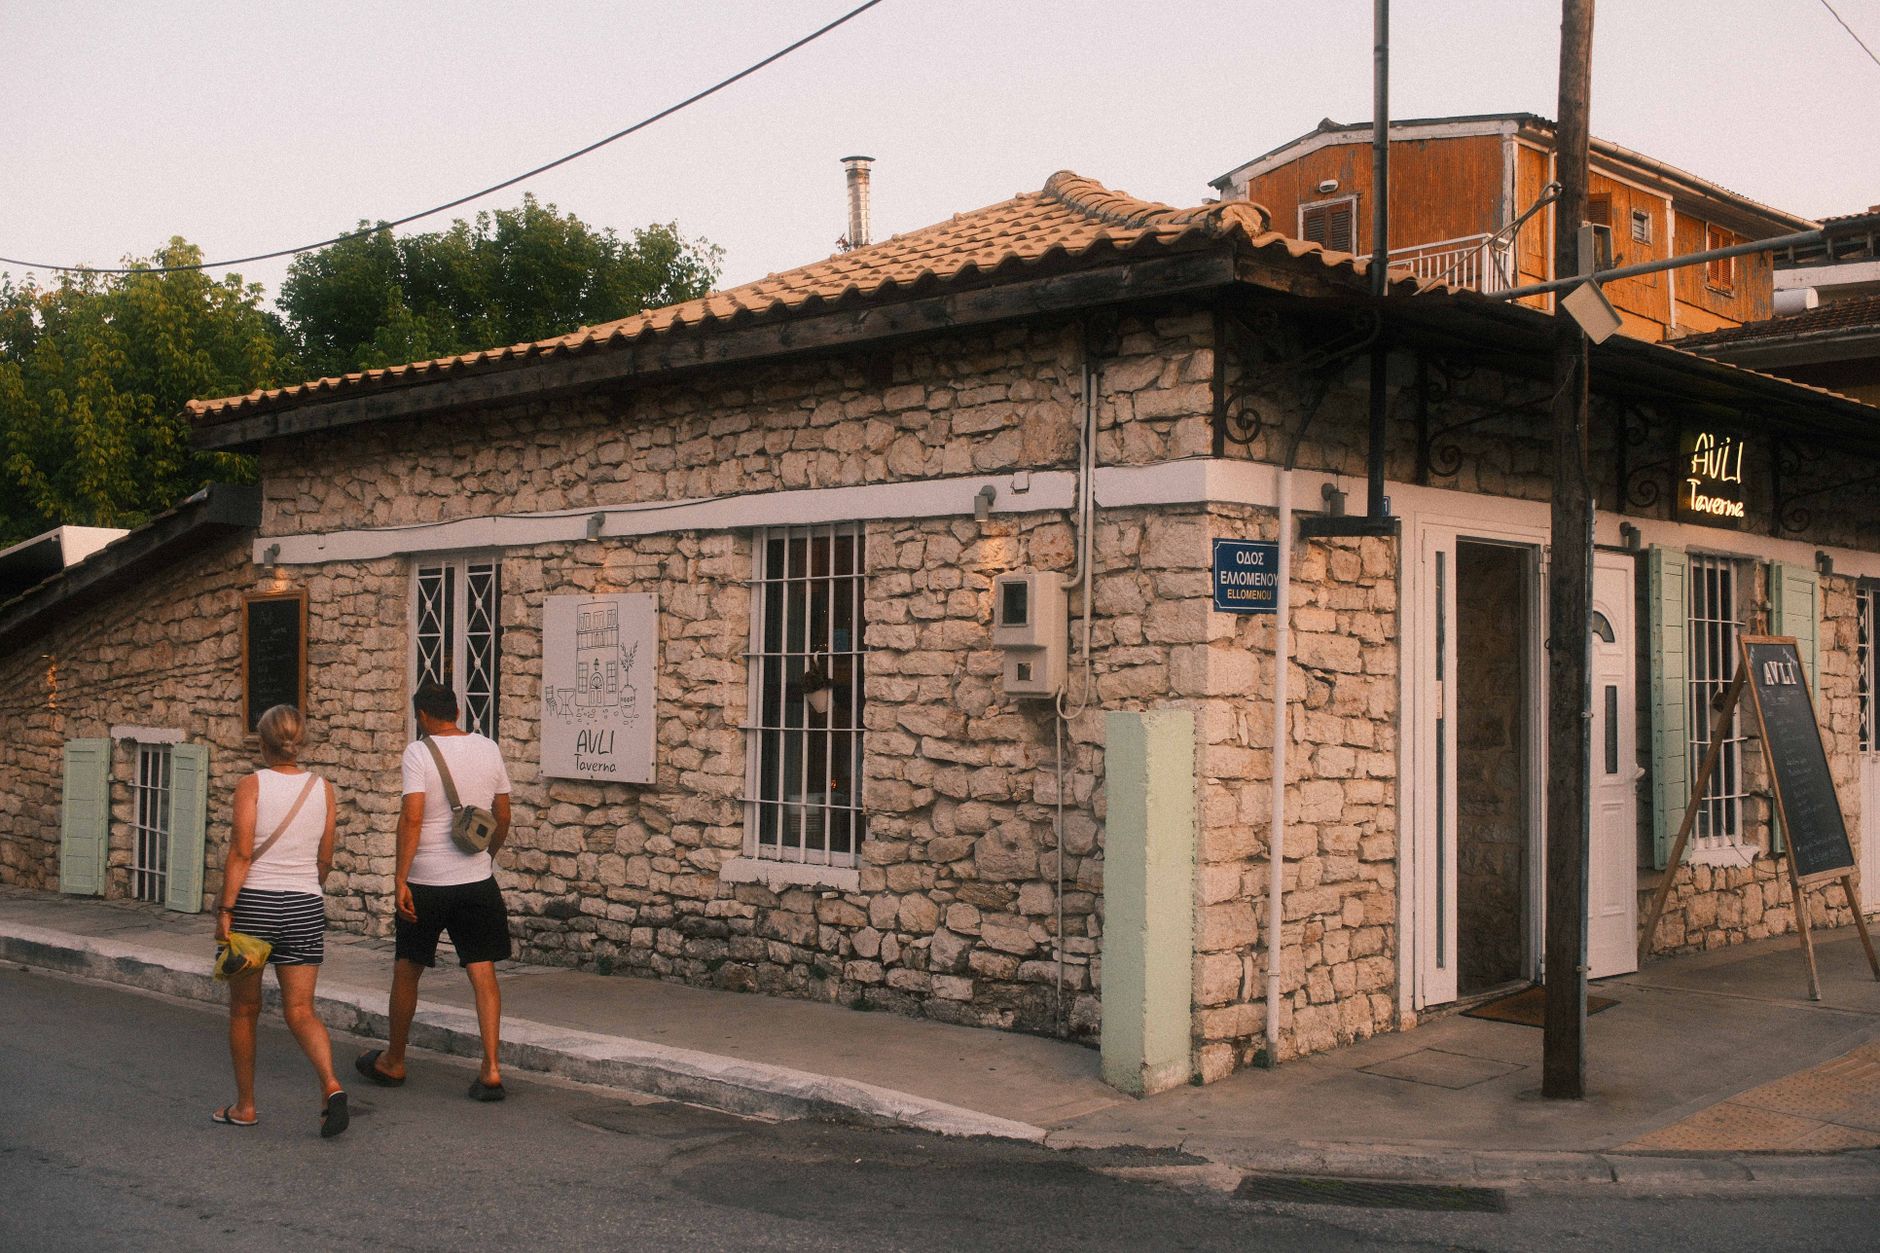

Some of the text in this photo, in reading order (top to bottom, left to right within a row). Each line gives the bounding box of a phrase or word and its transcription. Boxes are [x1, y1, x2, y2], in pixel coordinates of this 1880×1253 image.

[1691, 432, 1743, 484] AVLI
[1236, 551, 1264, 566] ΟΔΟΣ
[1227, 588, 1272, 600] ELLOMENOU
[1763, 661, 1797, 686] AVLI
[577, 729, 614, 755] AVLI
[574, 753, 616, 773] Taverna
